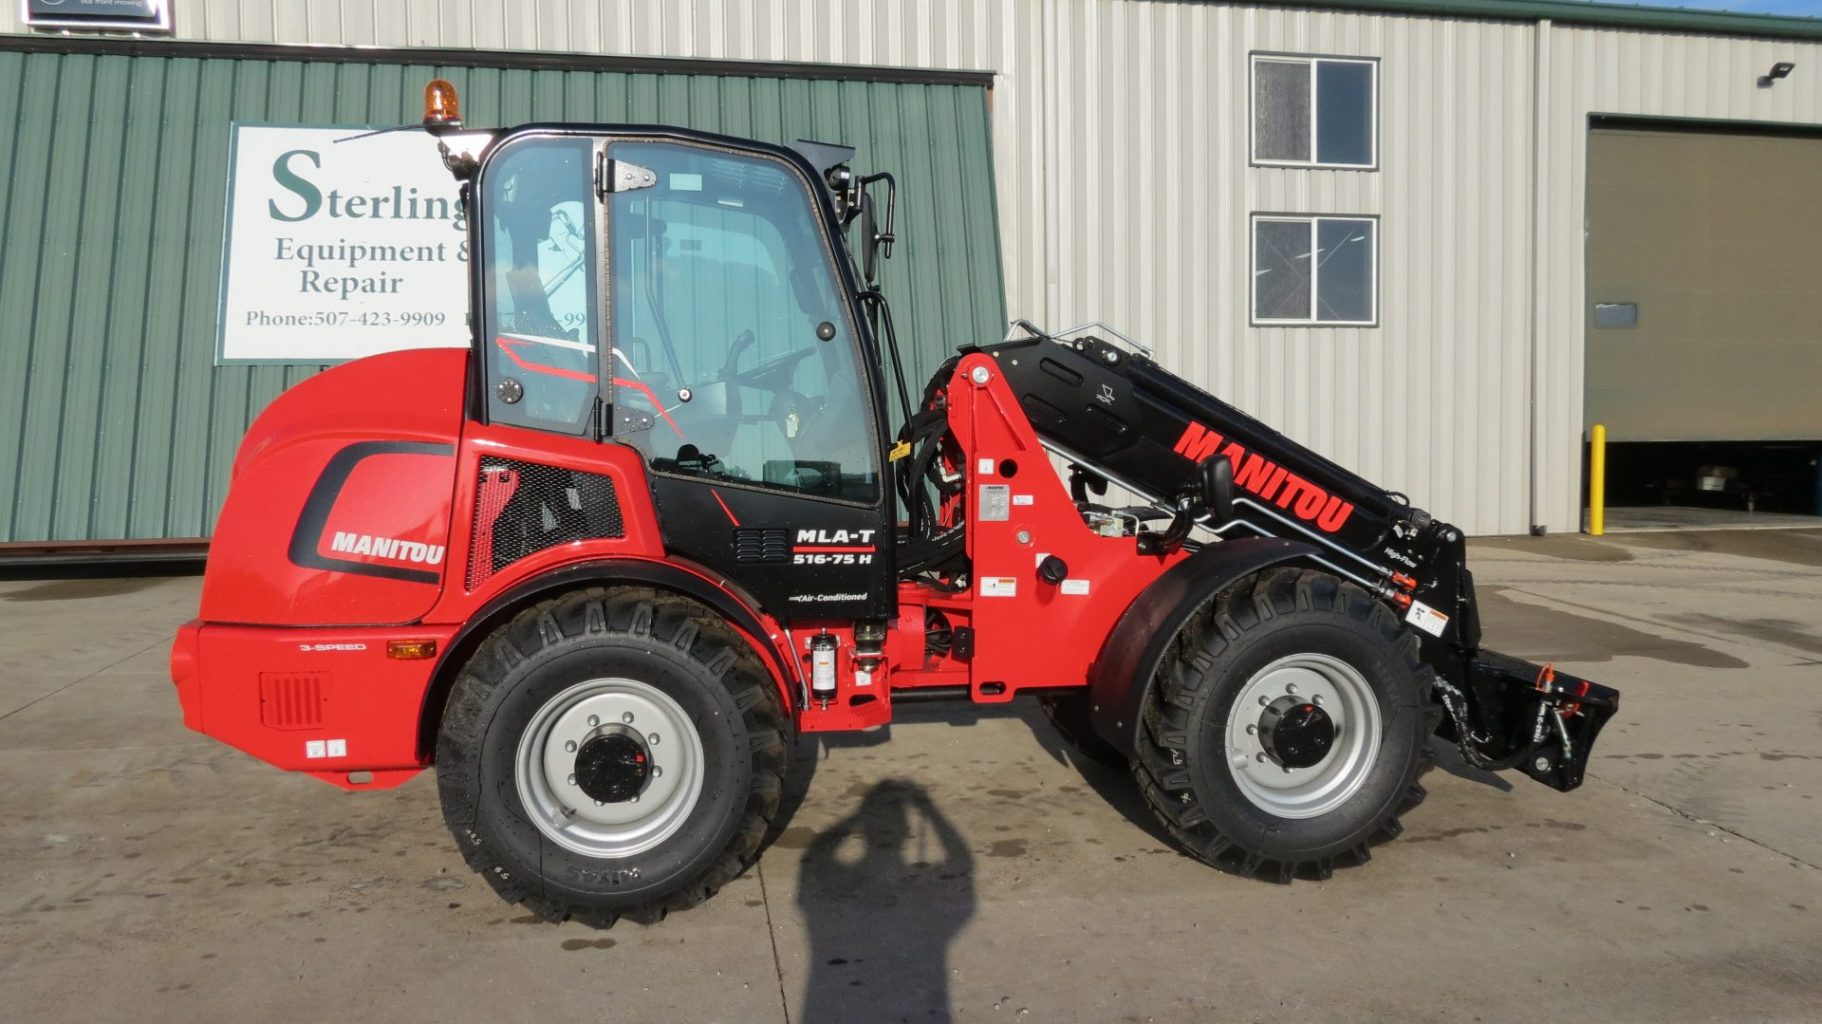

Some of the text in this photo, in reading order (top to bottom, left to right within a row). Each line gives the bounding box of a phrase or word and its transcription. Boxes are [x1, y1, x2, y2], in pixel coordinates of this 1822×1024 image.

[268, 149, 468, 231] Sterling
[274, 237, 447, 268] Equipment
[299, 270, 404, 300] Repair
[246, 310, 446, 328] Phone:507-423-9909
[797, 529, 875, 543] MLA-T
[331, 531, 445, 565] MANITOU
[1384, 546, 1417, 569] High-Flow
[793, 554, 872, 564] 516-75 H
[800, 592, 868, 602] Air-Conditioned
[299, 643, 367, 652] 3-SPEED
